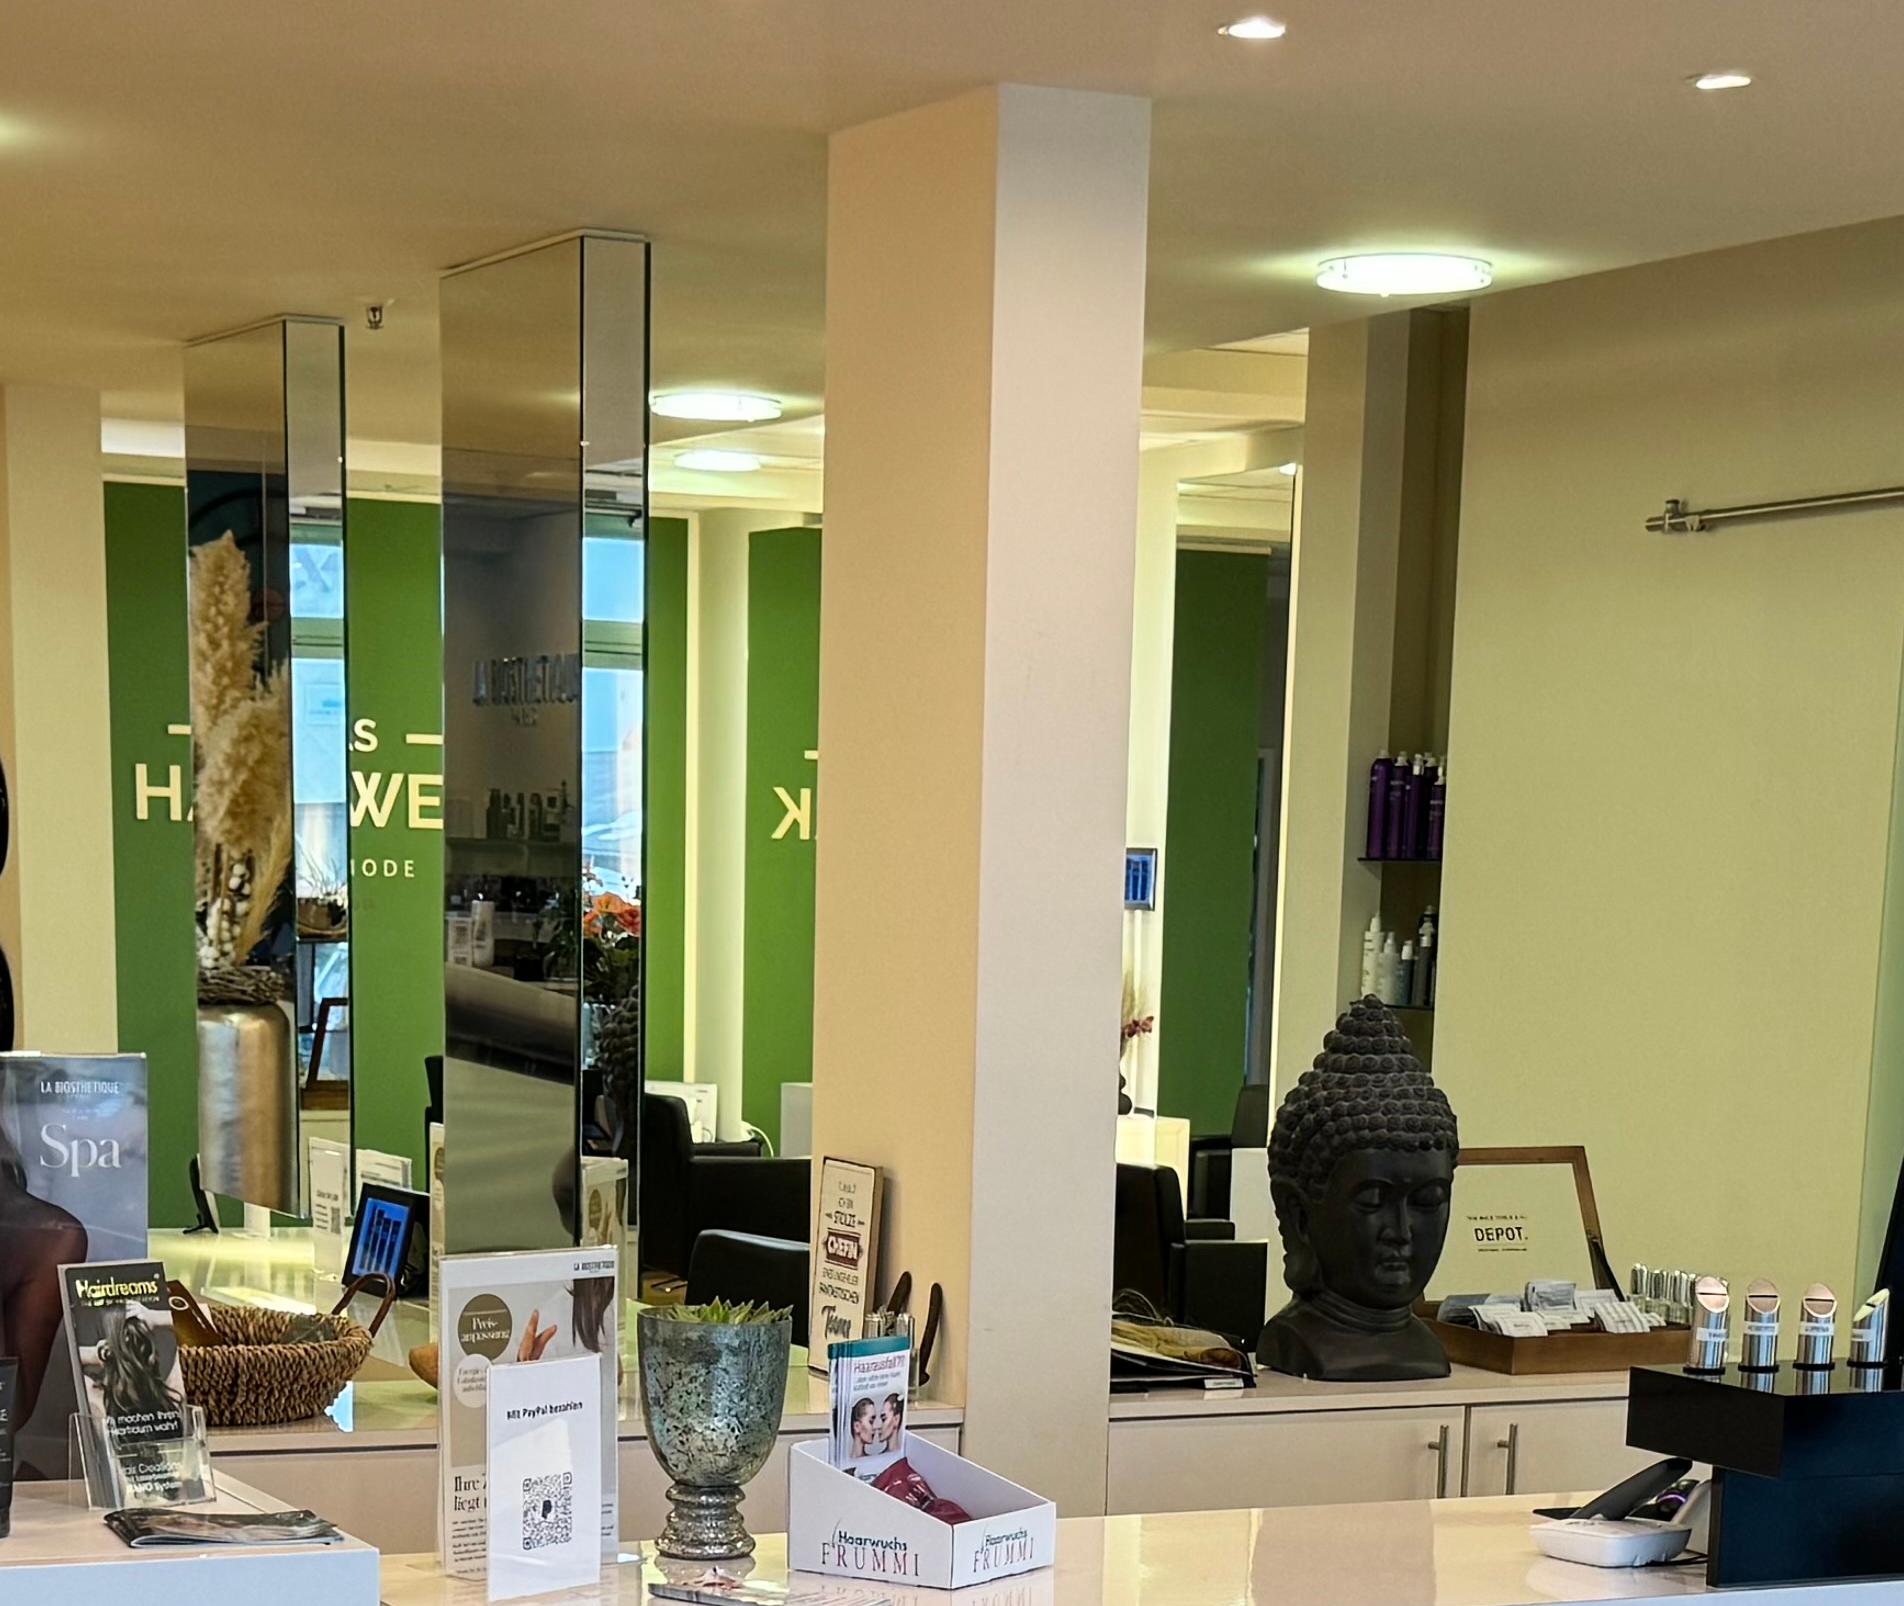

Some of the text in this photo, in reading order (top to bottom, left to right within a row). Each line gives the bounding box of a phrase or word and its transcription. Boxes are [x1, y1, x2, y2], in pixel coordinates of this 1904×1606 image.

[350, 857, 416, 879] ODE
[39, 1122, 122, 1178] Spa
[1473, 1226, 1529, 1242] DEPOT.
[826, 1234, 859, 1261] CHEFIN
[522, 1404, 548, 1419] PayPal
[549, 1401, 583, 1415] bezahlen
[838, 1530, 908, 1551] Haarwuchs
[821, 1542, 920, 1577] FRUMMI
[972, 1537, 1035, 1573] FRUMMI
